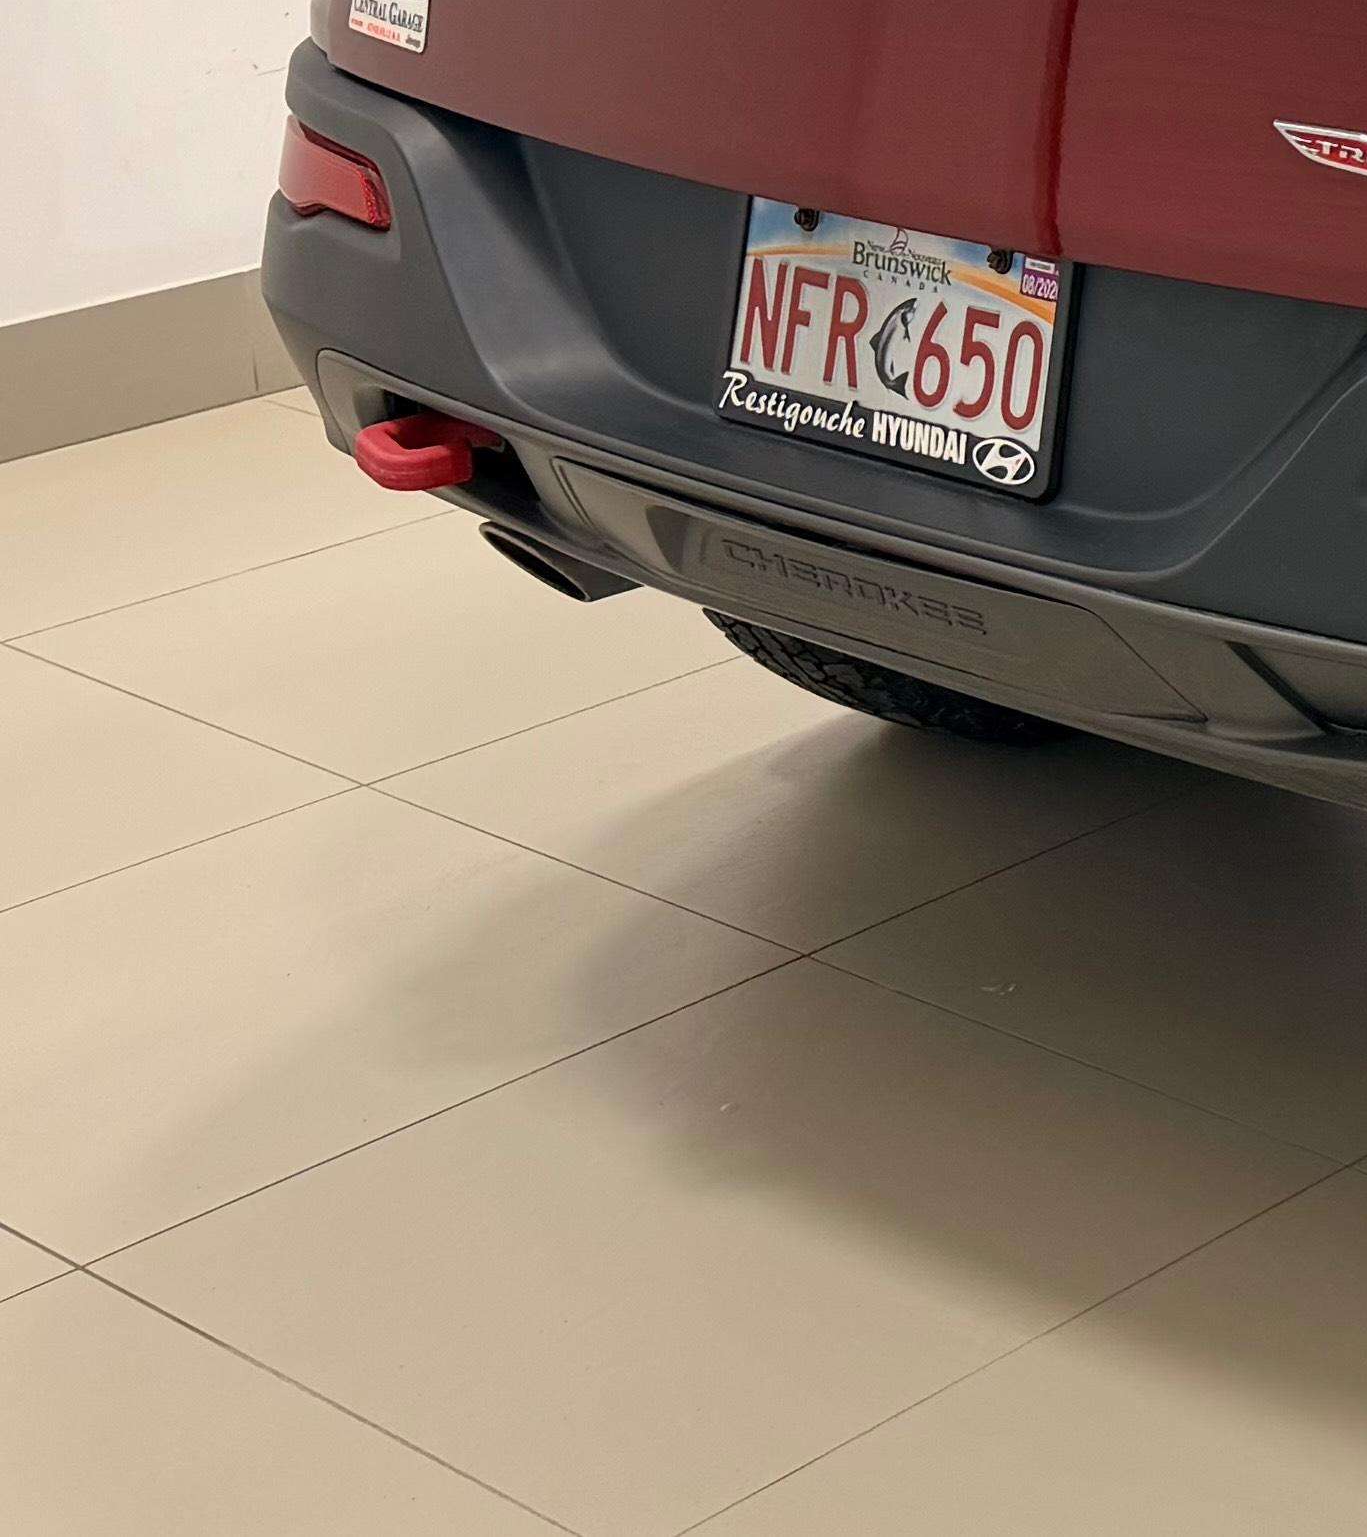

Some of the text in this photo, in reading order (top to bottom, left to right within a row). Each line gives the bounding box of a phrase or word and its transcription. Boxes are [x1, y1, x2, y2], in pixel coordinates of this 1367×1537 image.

[852, 240, 952, 286] Brunswick
[1021, 273, 1058, 299] 08/202
[739, 256, 1044, 431] NFR 650
[718, 370, 968, 465] Restigouche HYUNDAI
